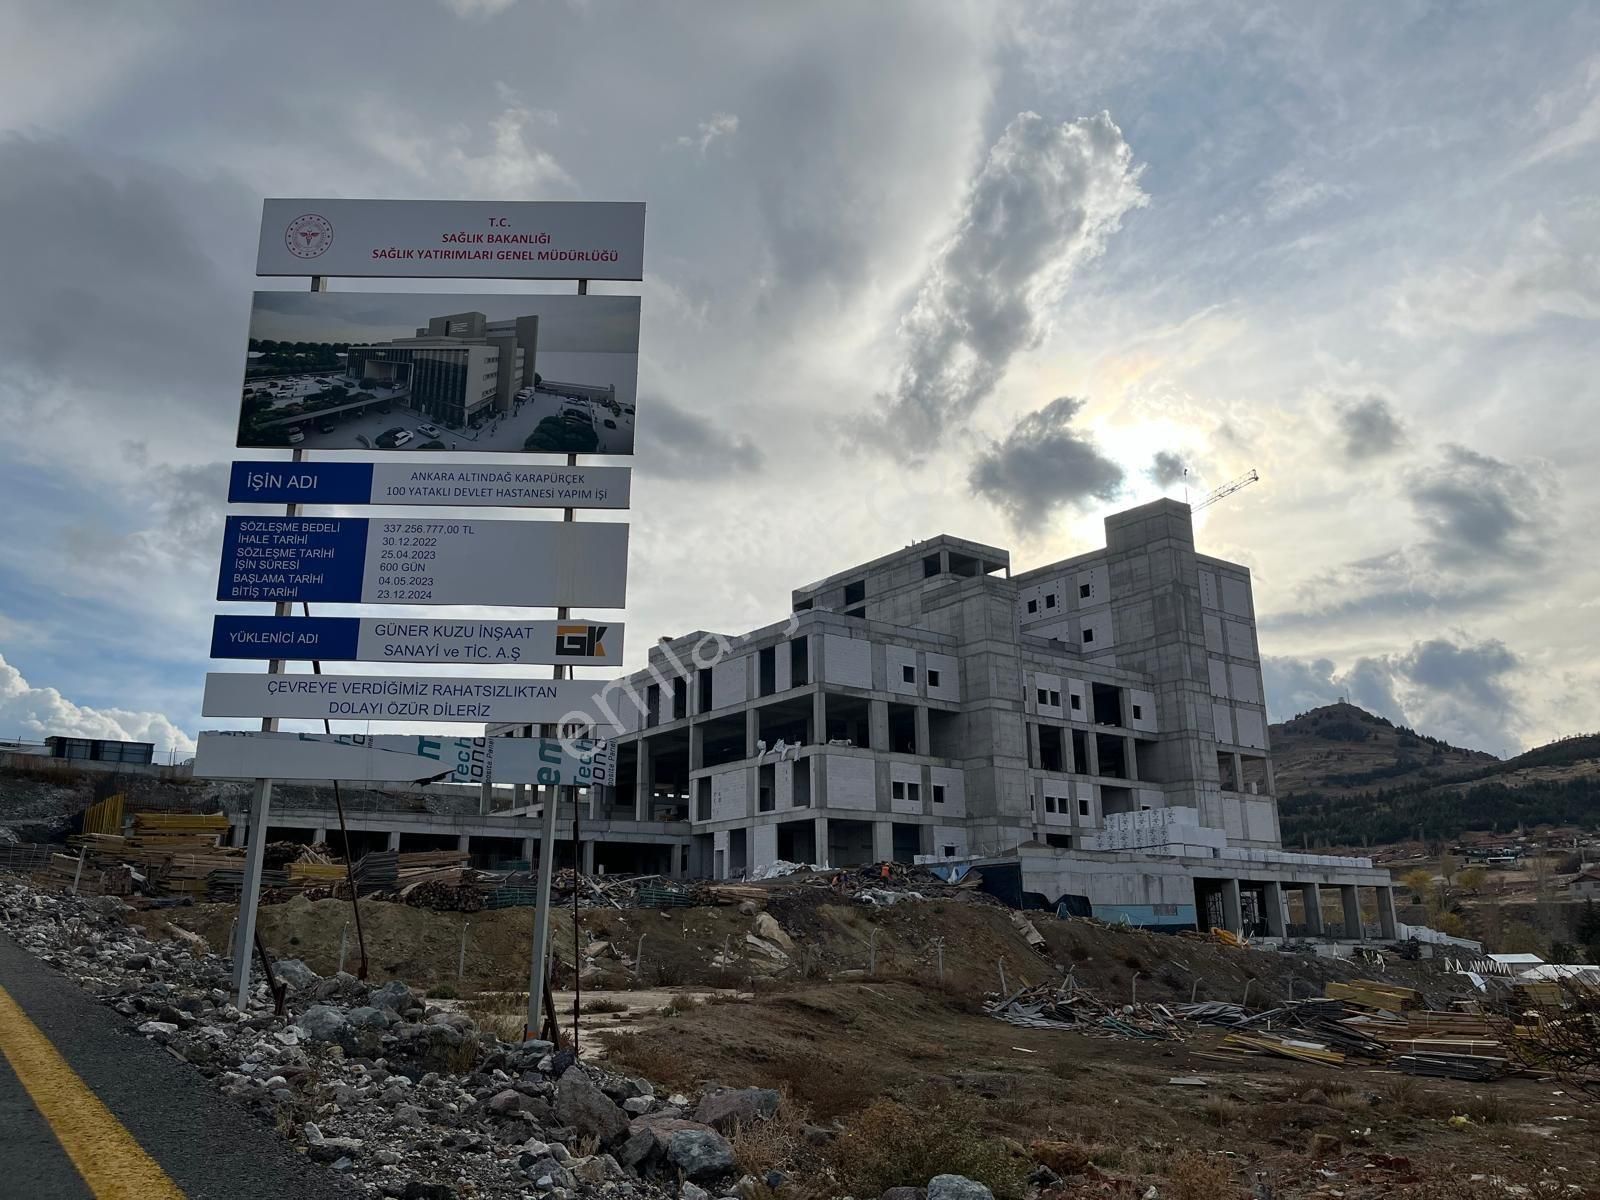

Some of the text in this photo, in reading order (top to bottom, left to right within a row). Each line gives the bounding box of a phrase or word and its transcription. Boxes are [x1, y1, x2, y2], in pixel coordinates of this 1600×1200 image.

[488, 217, 511, 227] T.C.
[442, 231, 551, 245] SAĞLIK BAKANLIĞI
[372, 247, 618, 262] SAĞLIK YATIRIMLARI GENEL MÜDÜRLÜĞÜ
[247, 472, 318, 491] İŞİN ADI
[410, 471, 585, 485] ANKARA ALTINDAĞ KARAPÜRÇEK
[386, 487, 608, 501] 100 YATAKLI DEVLET HASTANESİ YAPIM İŞİ
[240, 521, 340, 534] SÖZLEŞME BEDELİ
[463, 525, 475, 535] TL
[238, 533, 308, 545] İHALE TARİHİ
[382, 537, 437, 547] 30.12.2022
[236, 547, 335, 559] SÖZLEŞME TARİHİ
[381, 550, 436, 560] 25.04.2023
[235, 559, 300, 571] İŞİN SÜRESİ
[380, 561, 426, 572] 600 GÜN
[233, 573, 324, 585] BAŞLAMA TARİHİ
[378, 576, 434, 586] 04.05.2023
[231, 585, 298, 598] BİTİŞ TARİHİ
[377, 589, 432, 600] 23.12.2024
[230, 630, 319, 644] YÜKLENİCİ ADI
[375, 621, 534, 642] GÜNER KUZU İNŞAAT
[383, 643, 440, 657] SANAYİ
[443, 648, 459, 658] ve
[464, 645, 492, 659] TİC.
[267, 680, 558, 699] ÇEVREYE VERDİĞİMİZ RAHATSIZLIKTAN
[329, 700, 491, 717] DOLAYI ÖZÜR DİLERİZ
